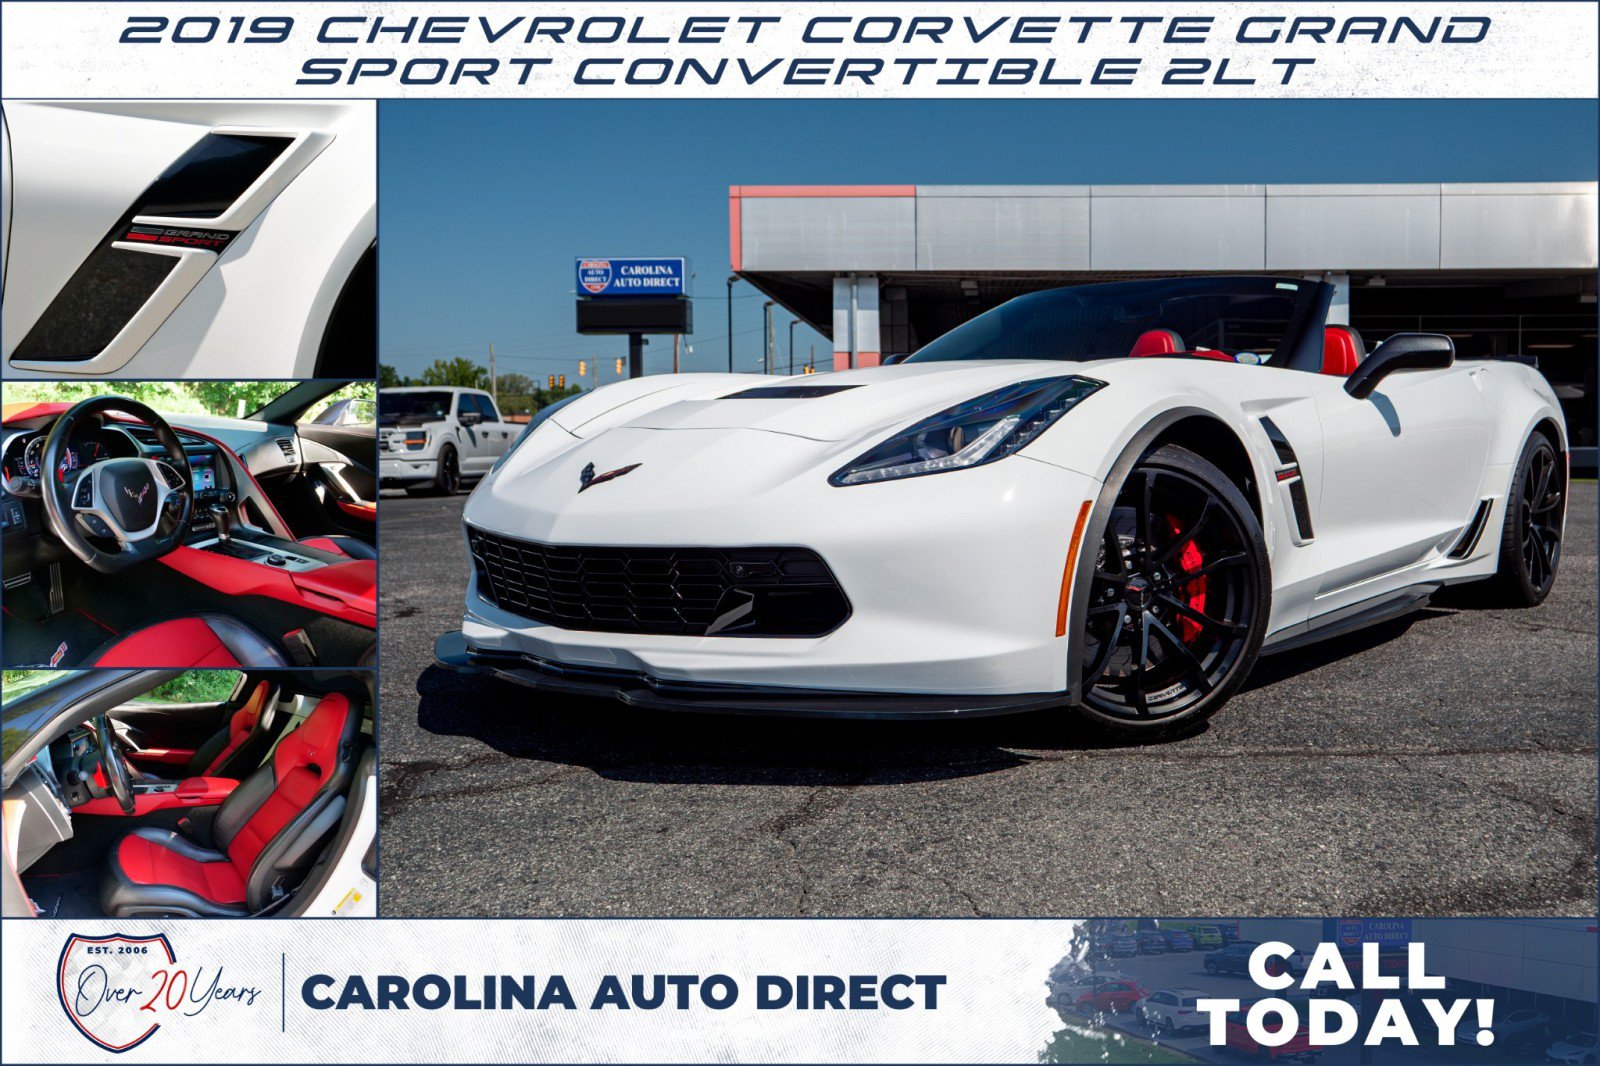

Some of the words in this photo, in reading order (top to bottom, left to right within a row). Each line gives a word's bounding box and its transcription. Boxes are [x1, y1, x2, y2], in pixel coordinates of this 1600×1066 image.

[164, 229, 230, 240] GRAND
[158, 235, 226, 247] SPORT
[620, 265, 674, 276] CAROLINA
[613, 278, 641, 288] AUTO
[643, 277, 680, 287] DIRECT
[1369, 922, 1405, 930] CAROLINA
[1364, 933, 1383, 941] AUTO
